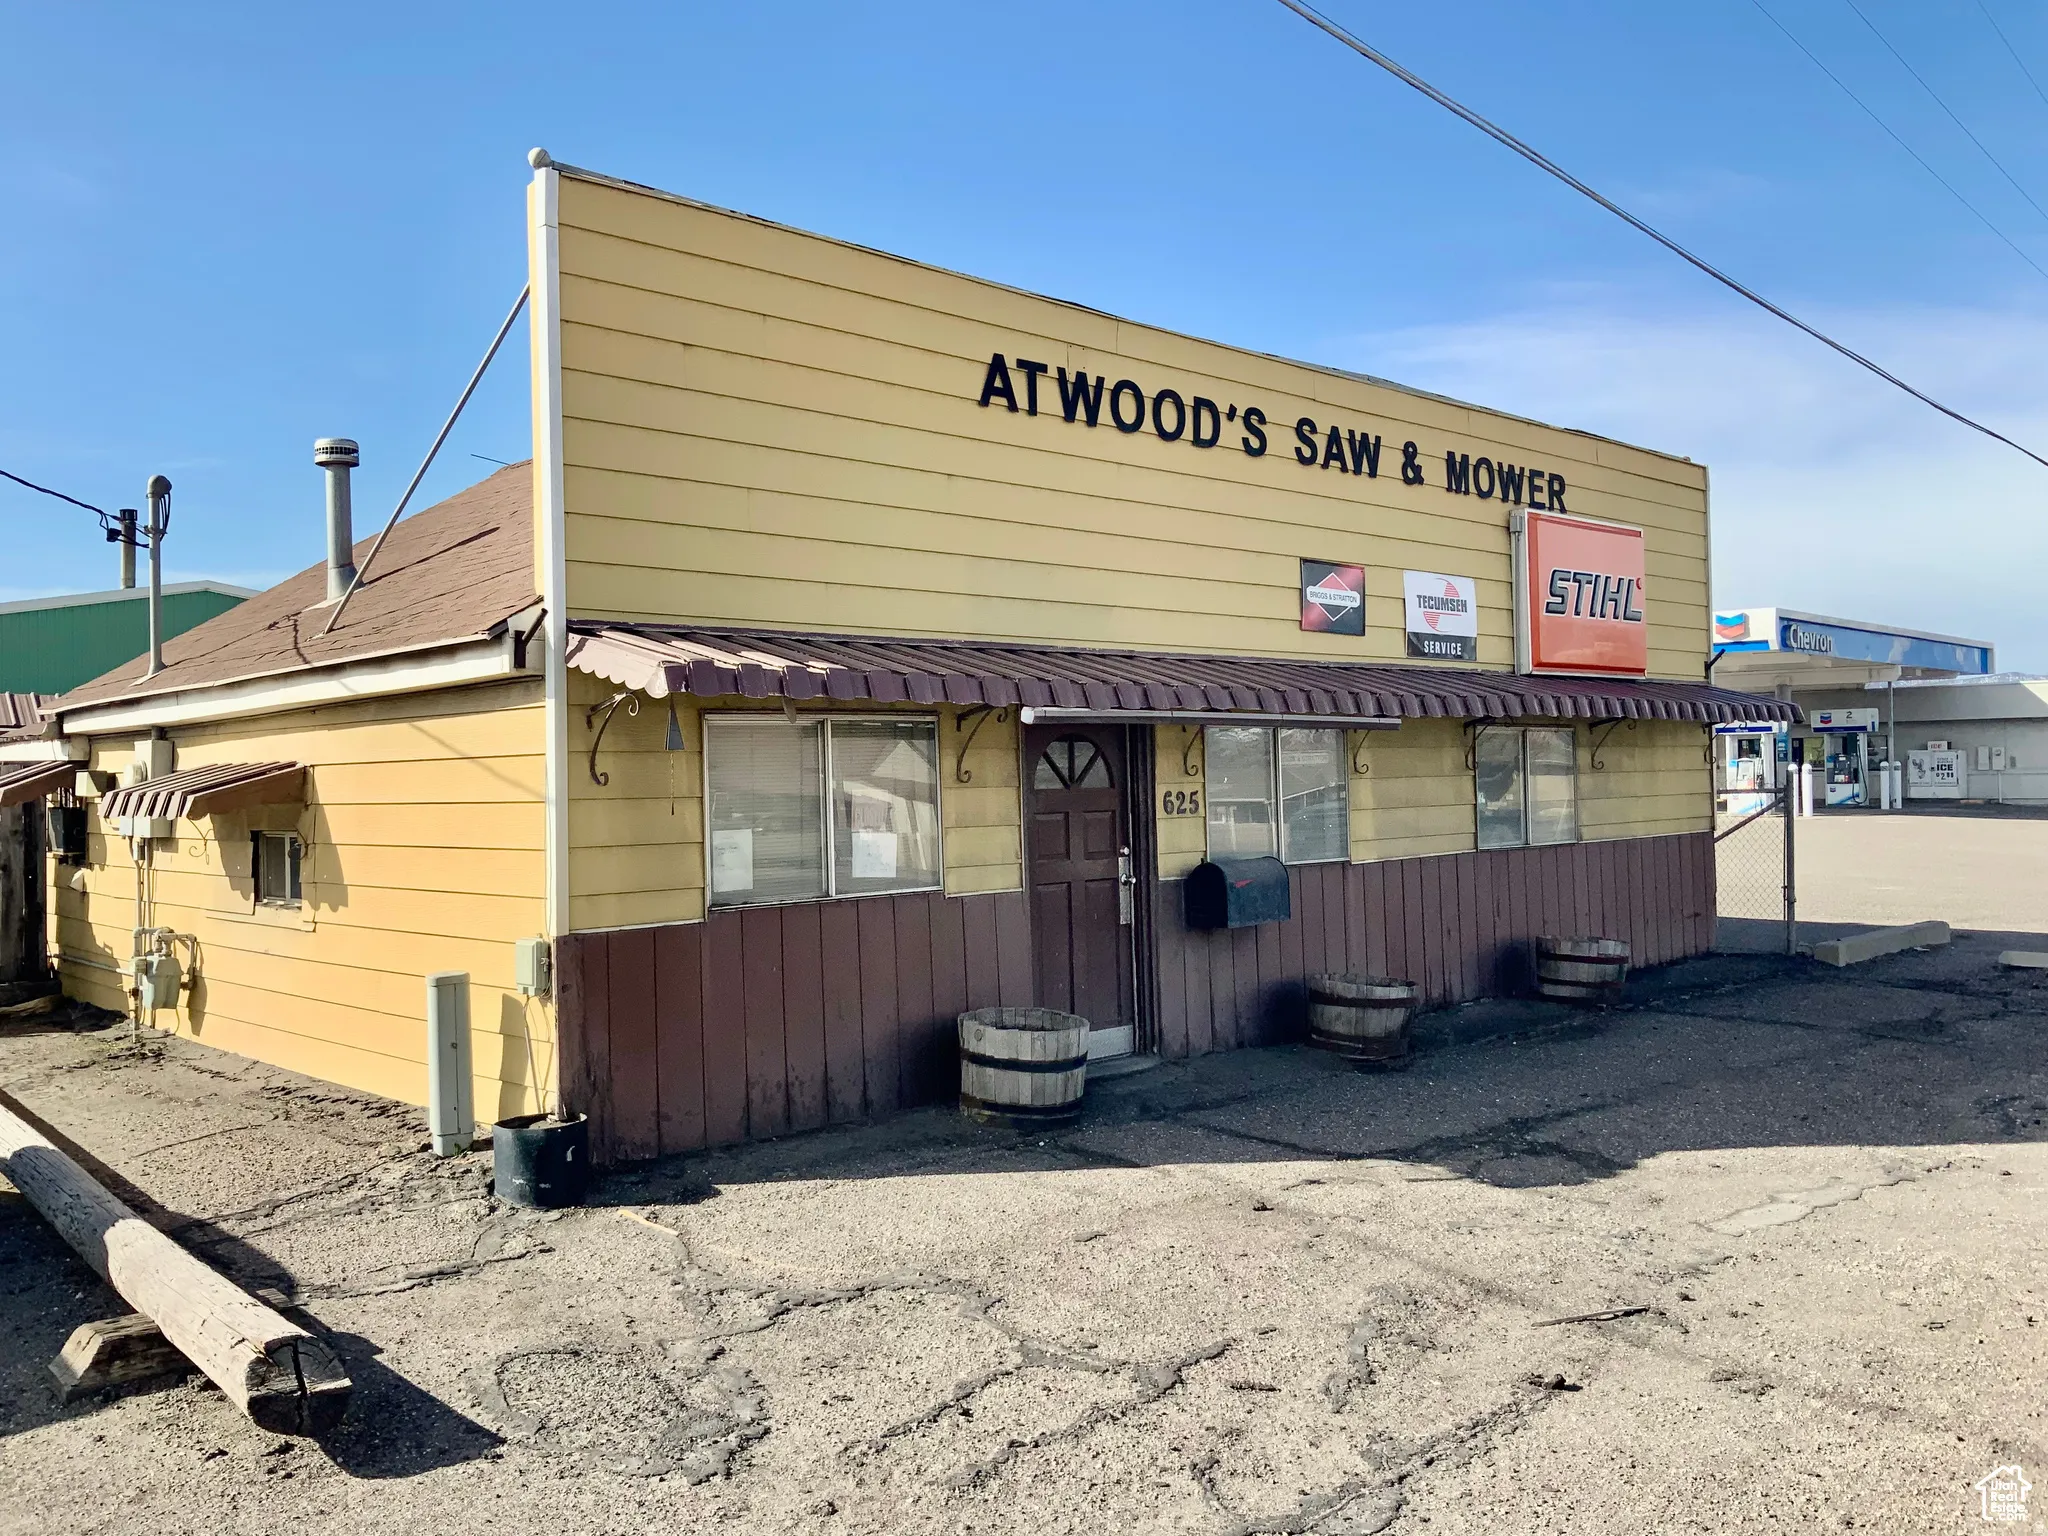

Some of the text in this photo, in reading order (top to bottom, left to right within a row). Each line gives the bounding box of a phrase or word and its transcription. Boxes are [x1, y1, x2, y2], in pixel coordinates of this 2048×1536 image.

[979, 353, 1568, 514] ATWOOD'S SAW & MOWER
[1309, 590, 1328, 600] BRIGGS
[1333, 594, 1358, 603] STRATTON
[1416, 594, 1468, 613] TECUMSEH
[1543, 566, 1643, 624] STIHL
[1424, 640, 1462, 655] SERVICE
[1790, 623, 1833, 652] Chevron
[1846, 711, 1852, 719] 2
[1163, 789, 1200, 816] 625
